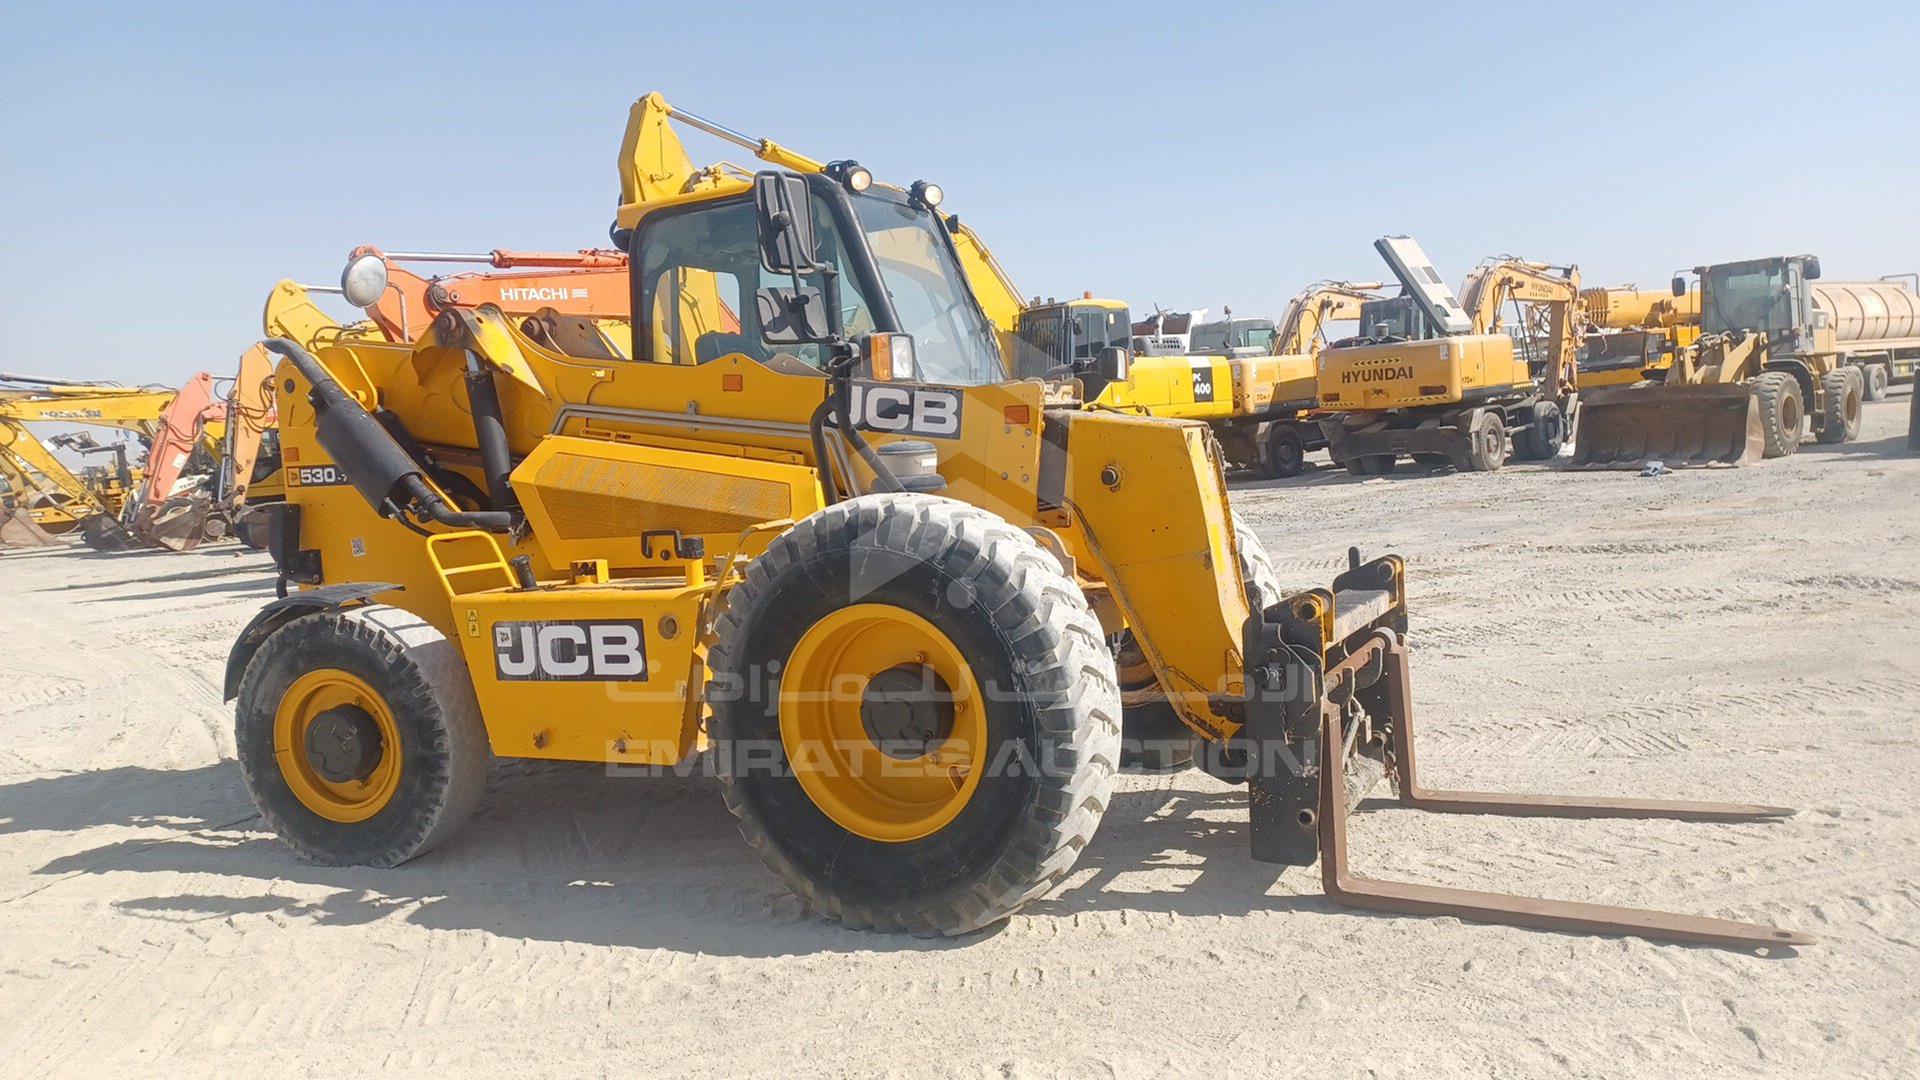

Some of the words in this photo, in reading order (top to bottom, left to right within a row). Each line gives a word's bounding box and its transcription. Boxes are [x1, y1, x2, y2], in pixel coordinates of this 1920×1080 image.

[500, 287, 568, 301] HITACHI
[1341, 366, 1414, 385] HYUNDAI
[1194, 382, 1211, 395] 400
[827, 385, 958, 434] JCB
[497, 624, 643, 676] JCB
